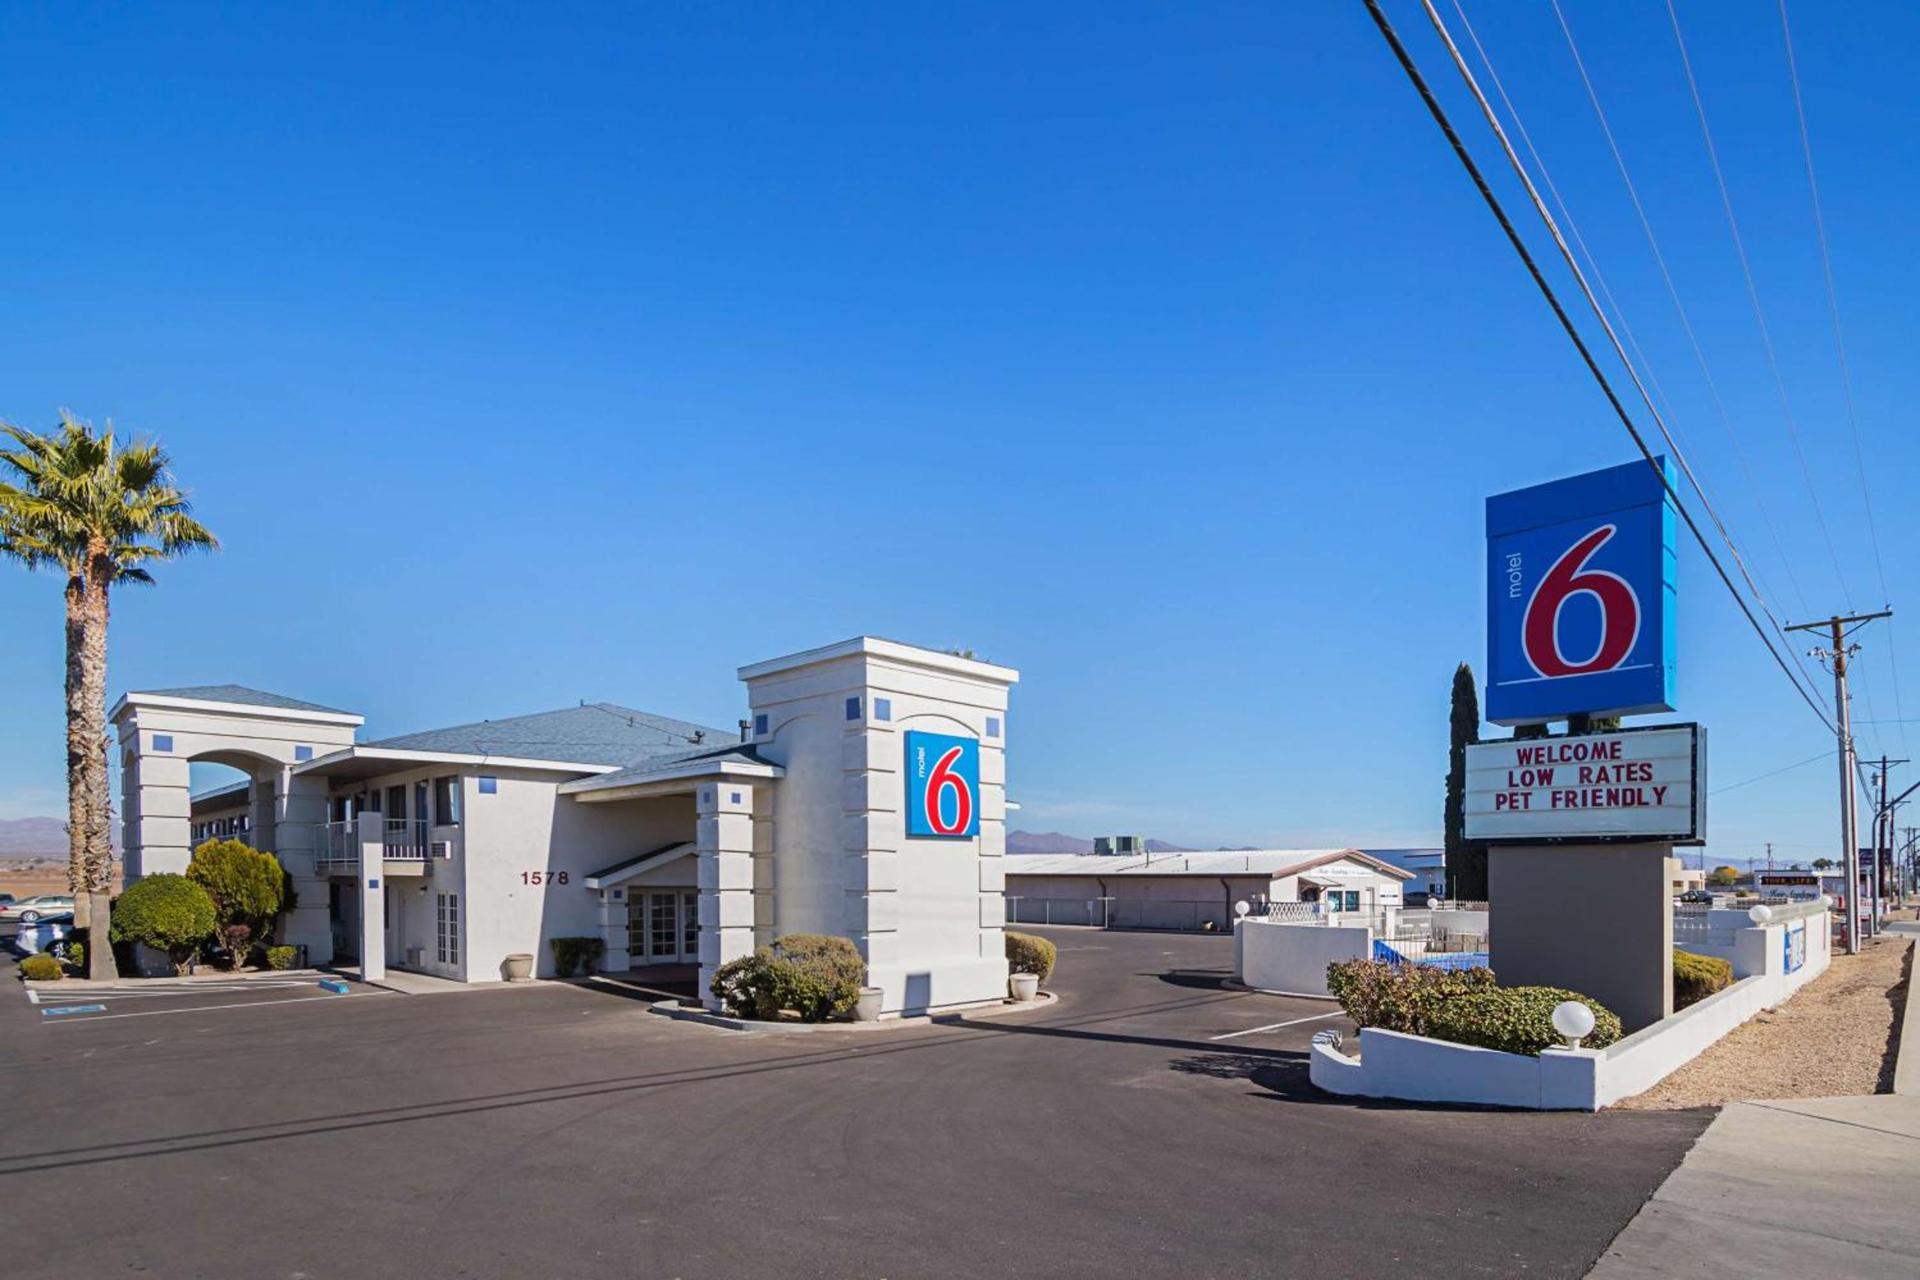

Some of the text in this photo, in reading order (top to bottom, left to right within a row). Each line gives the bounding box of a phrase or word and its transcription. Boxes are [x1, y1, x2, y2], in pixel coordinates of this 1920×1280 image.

[1506, 523, 1642, 679] motel 6
[1516, 741, 1622, 767] WELCOME
[1508, 762, 1653, 788] LOW RATES
[917, 745, 972, 835] motel 6
[1495, 786, 1668, 811] PET FRIENDLY
[521, 871, 569, 885] 1578
